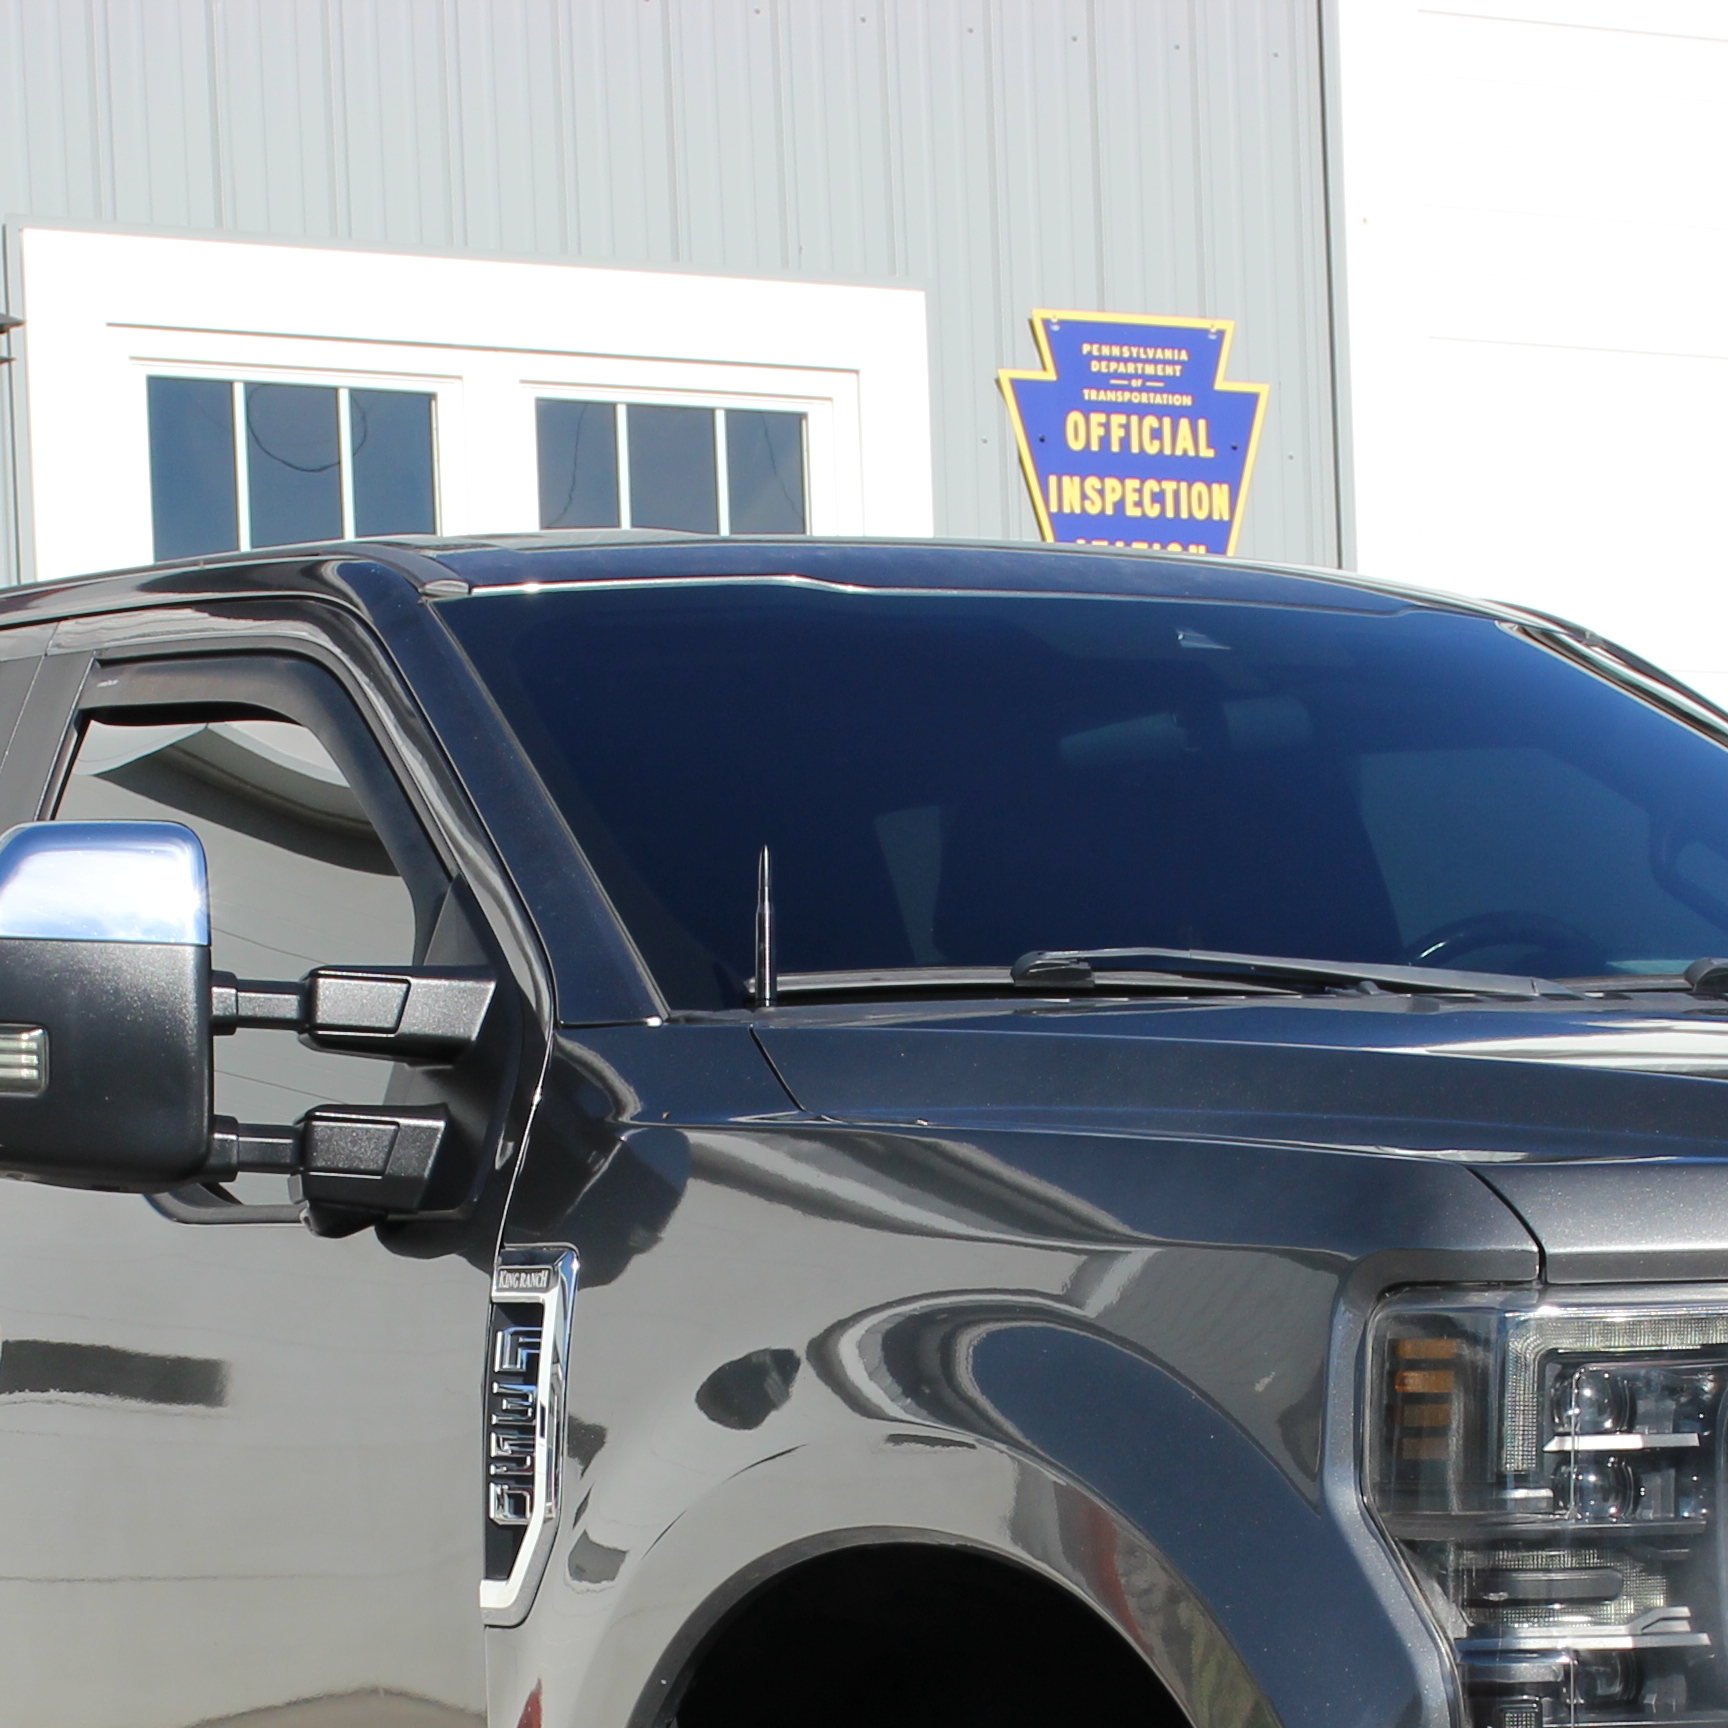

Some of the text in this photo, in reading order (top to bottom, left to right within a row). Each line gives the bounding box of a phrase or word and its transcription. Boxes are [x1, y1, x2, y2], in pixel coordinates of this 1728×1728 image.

[1081, 342, 1189, 362] PENNSYLVANIA
[1090, 360, 1183, 377] DEPARTMENT
[1130, 378, 1144, 389] OF
[1082, 388, 1193, 407] TRANSPORTATION
[1065, 410, 1216, 458] OFFICIAL
[1048, 474, 1231, 522] INSPECTION
[499, 1269, 549, 1289] KING RANCH
